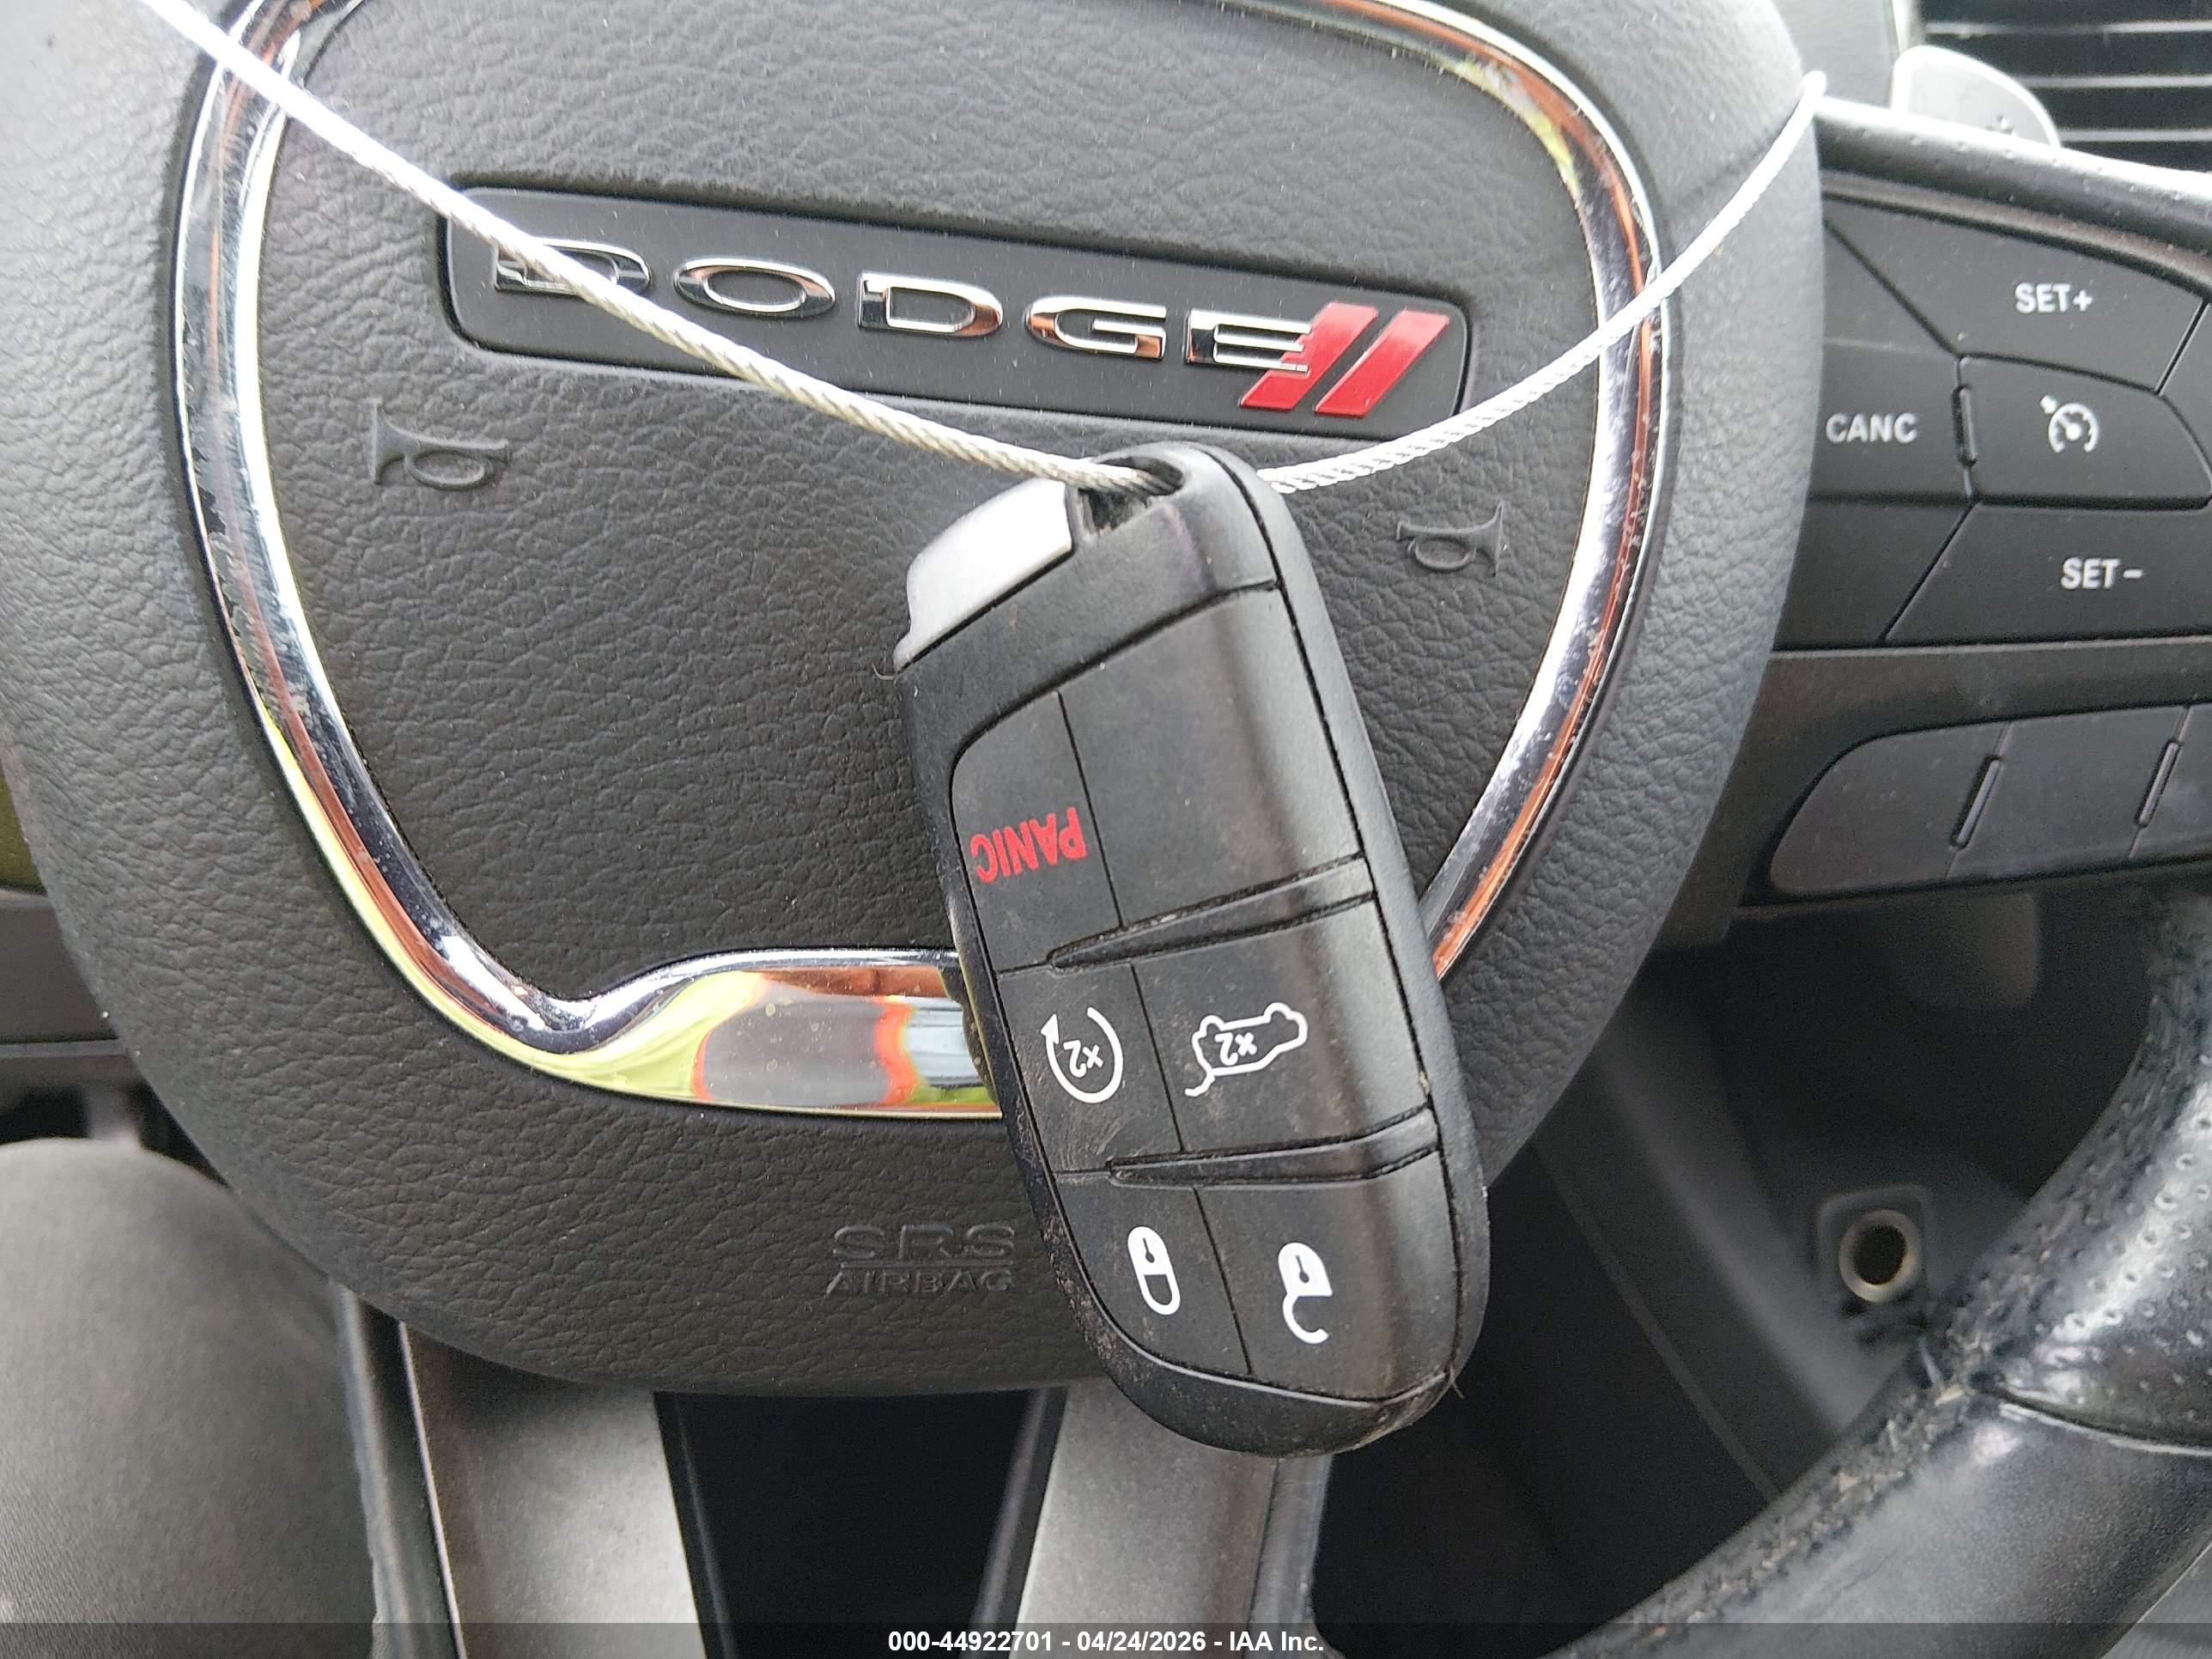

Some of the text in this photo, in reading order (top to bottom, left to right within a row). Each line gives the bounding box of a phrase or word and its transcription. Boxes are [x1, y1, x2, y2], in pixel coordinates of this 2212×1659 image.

[495, 238, 1313, 373] DODGE
[2014, 283, 2093, 313] SET+
[1826, 413, 1918, 444] CANC
[970, 806, 1087, 883] PANIC
[833, 1223, 1015, 1260] SRS
[824, 1268, 1013, 1295] AIRBAG
